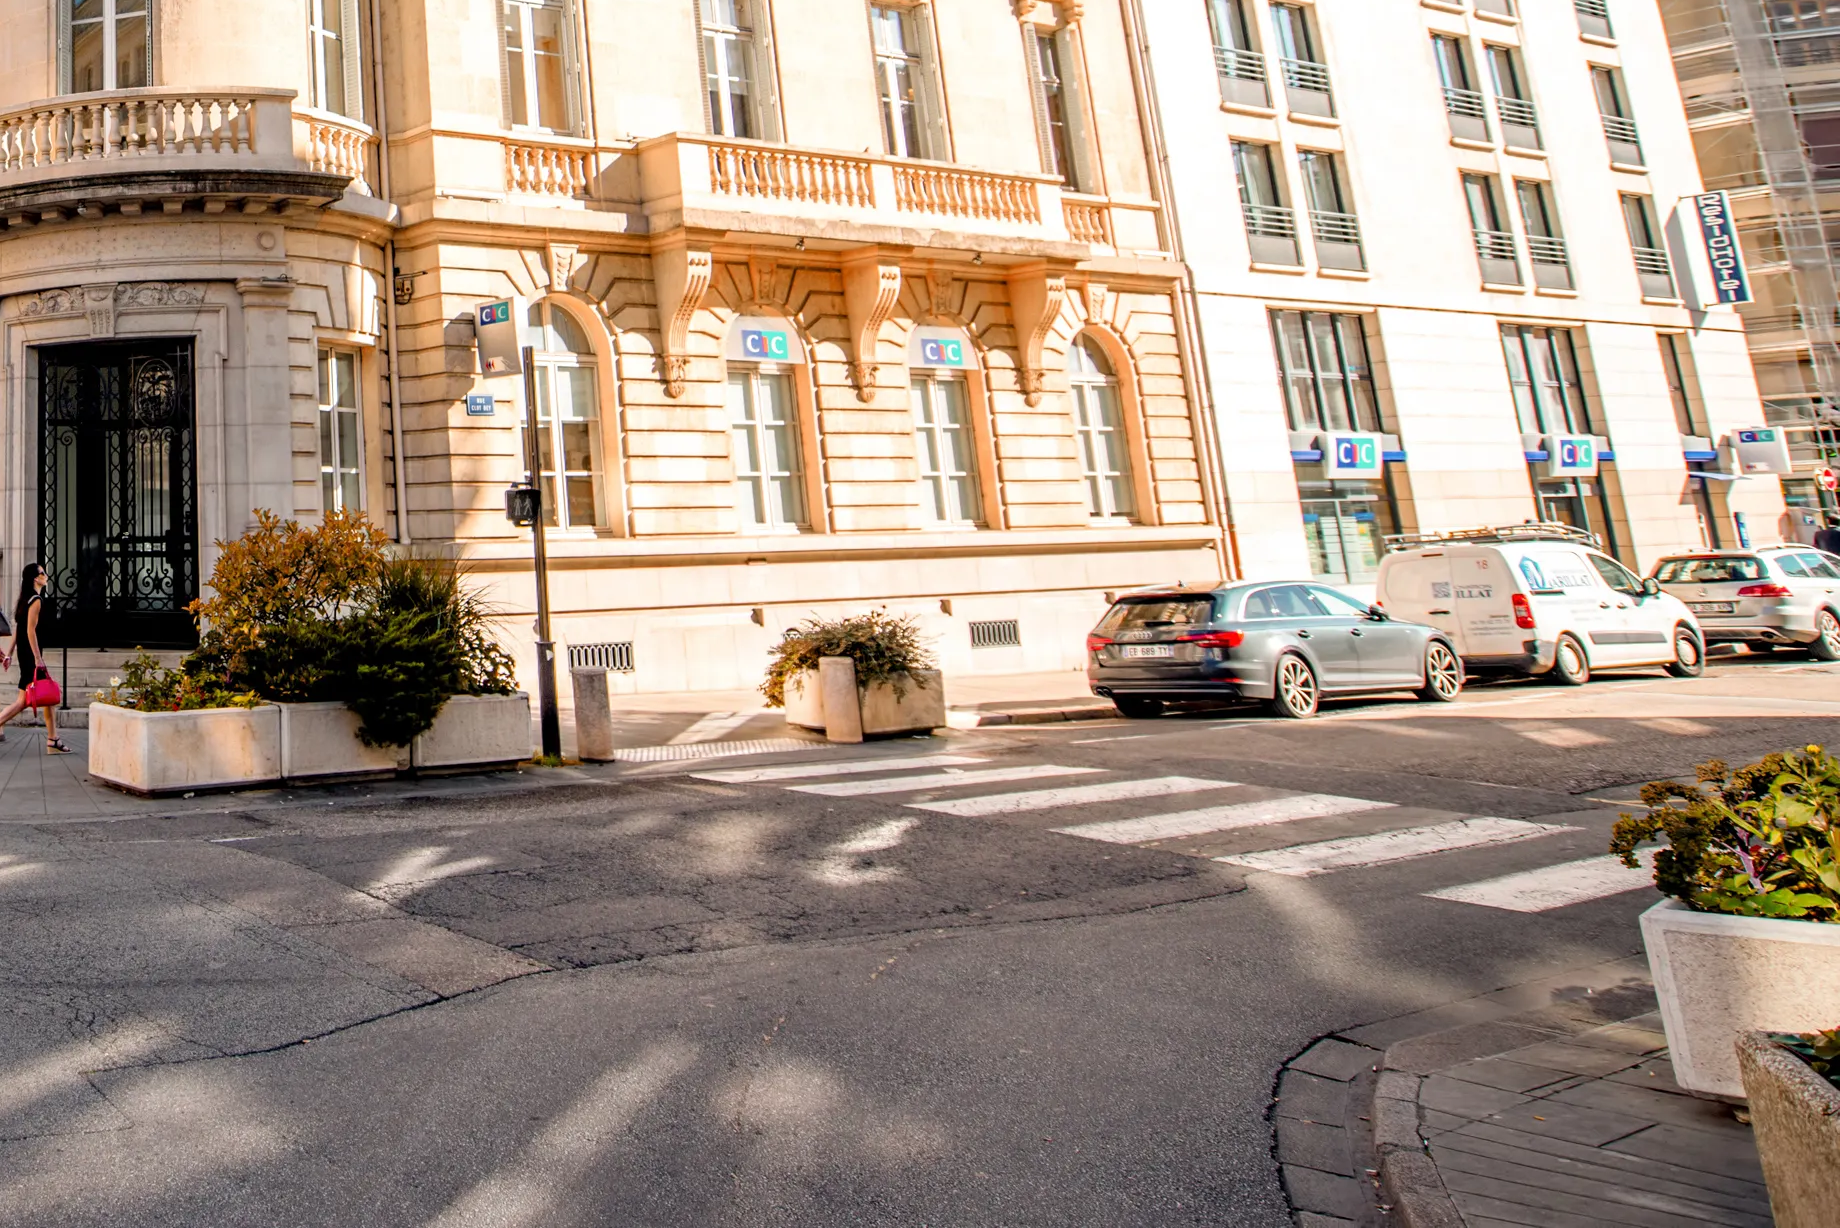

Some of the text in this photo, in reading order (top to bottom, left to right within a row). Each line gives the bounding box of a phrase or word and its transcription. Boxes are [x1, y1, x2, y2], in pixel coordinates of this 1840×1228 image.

[745, 333, 785, 355] CIC
[924, 342, 961, 362] CIC
[1338, 442, 1373, 463] CIC
[1562, 444, 1590, 463] CIC
